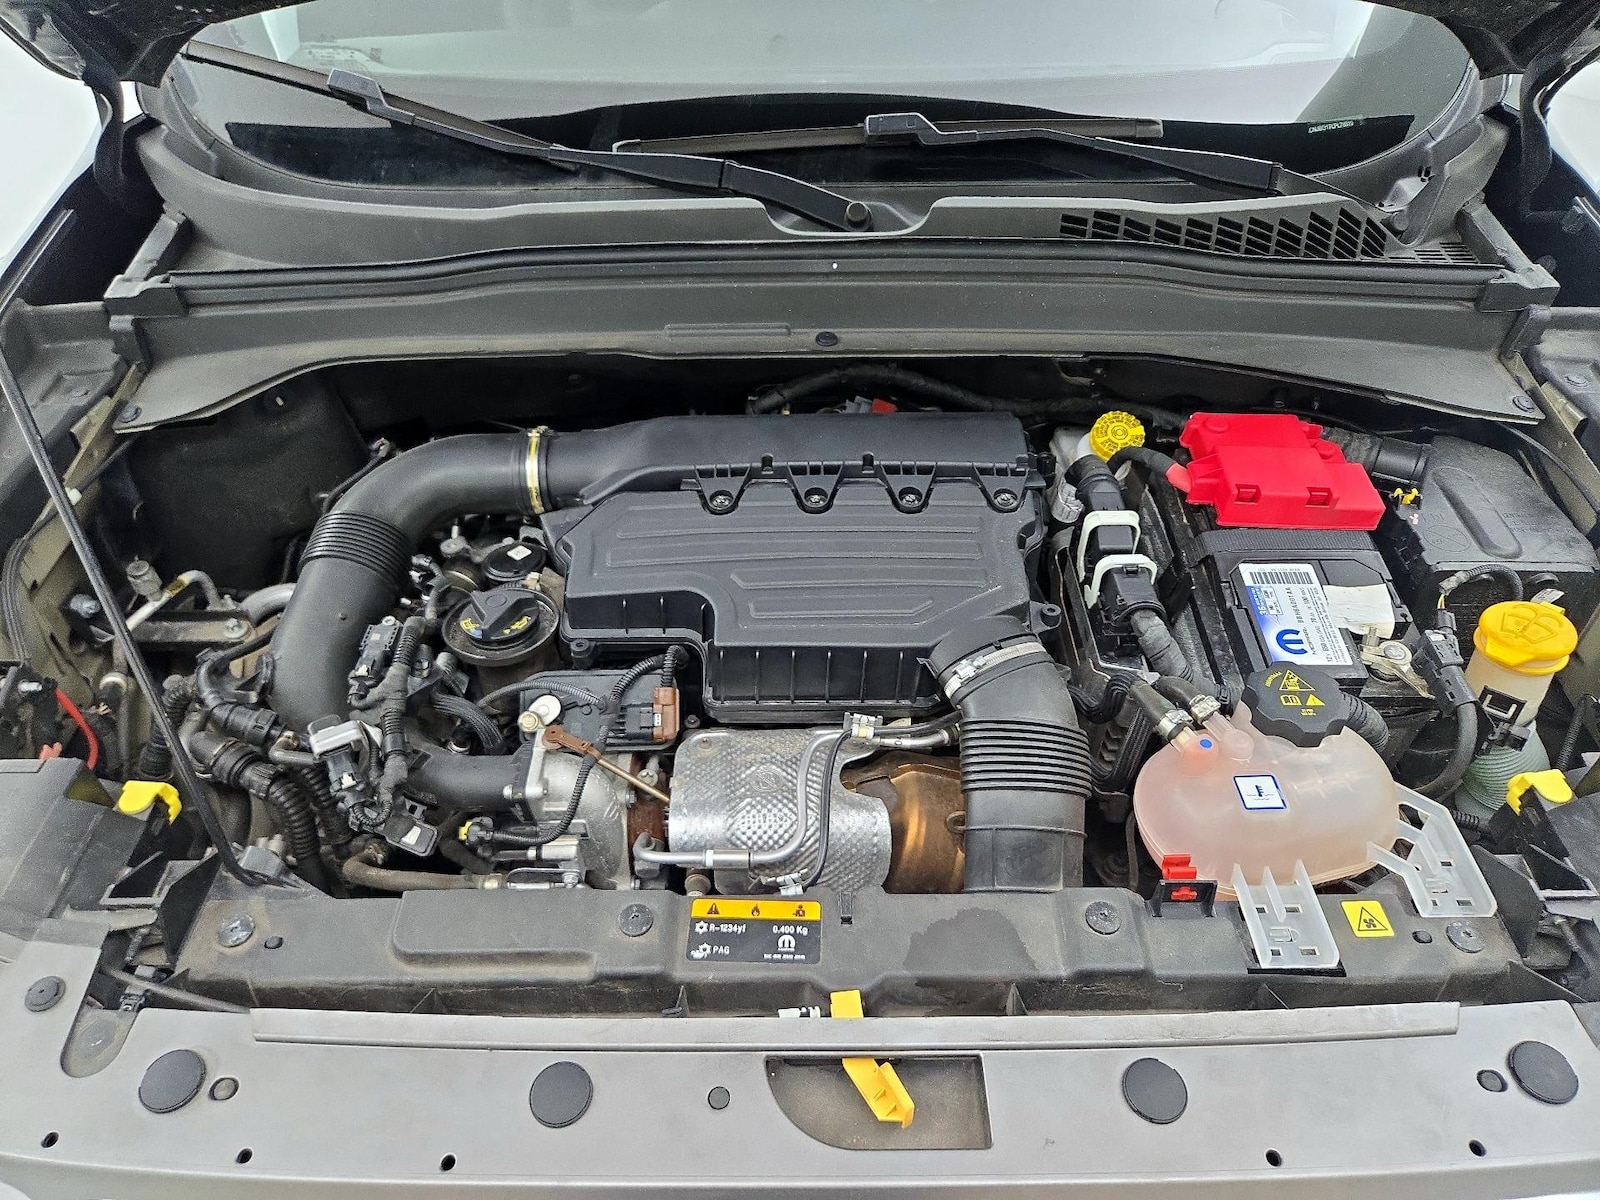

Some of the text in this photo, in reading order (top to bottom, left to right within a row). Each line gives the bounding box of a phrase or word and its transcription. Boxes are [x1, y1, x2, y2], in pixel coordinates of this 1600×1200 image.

[709, 923, 746, 934] R-1234yf
[772, 925, 808, 936] 0.400 Kg
[712, 945, 730, 955] PAG
